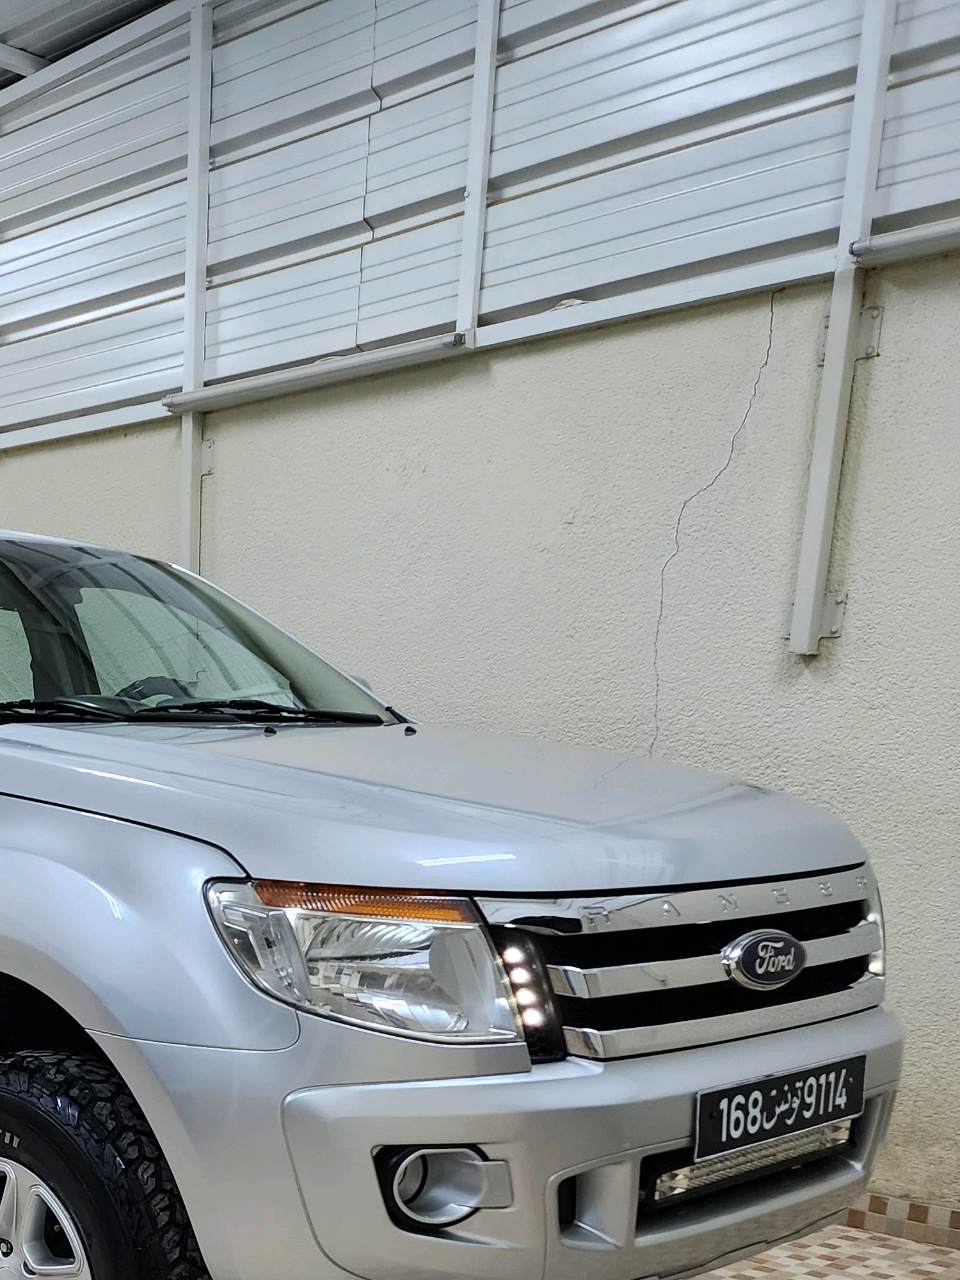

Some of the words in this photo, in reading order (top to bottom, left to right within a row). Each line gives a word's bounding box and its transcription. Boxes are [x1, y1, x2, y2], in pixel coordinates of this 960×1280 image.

[755, 941, 795, 975] Ford
[719, 1090, 763, 1142] 168
[762, 1080, 803, 1130] تونس
[802, 1068, 847, 1119] 9114
